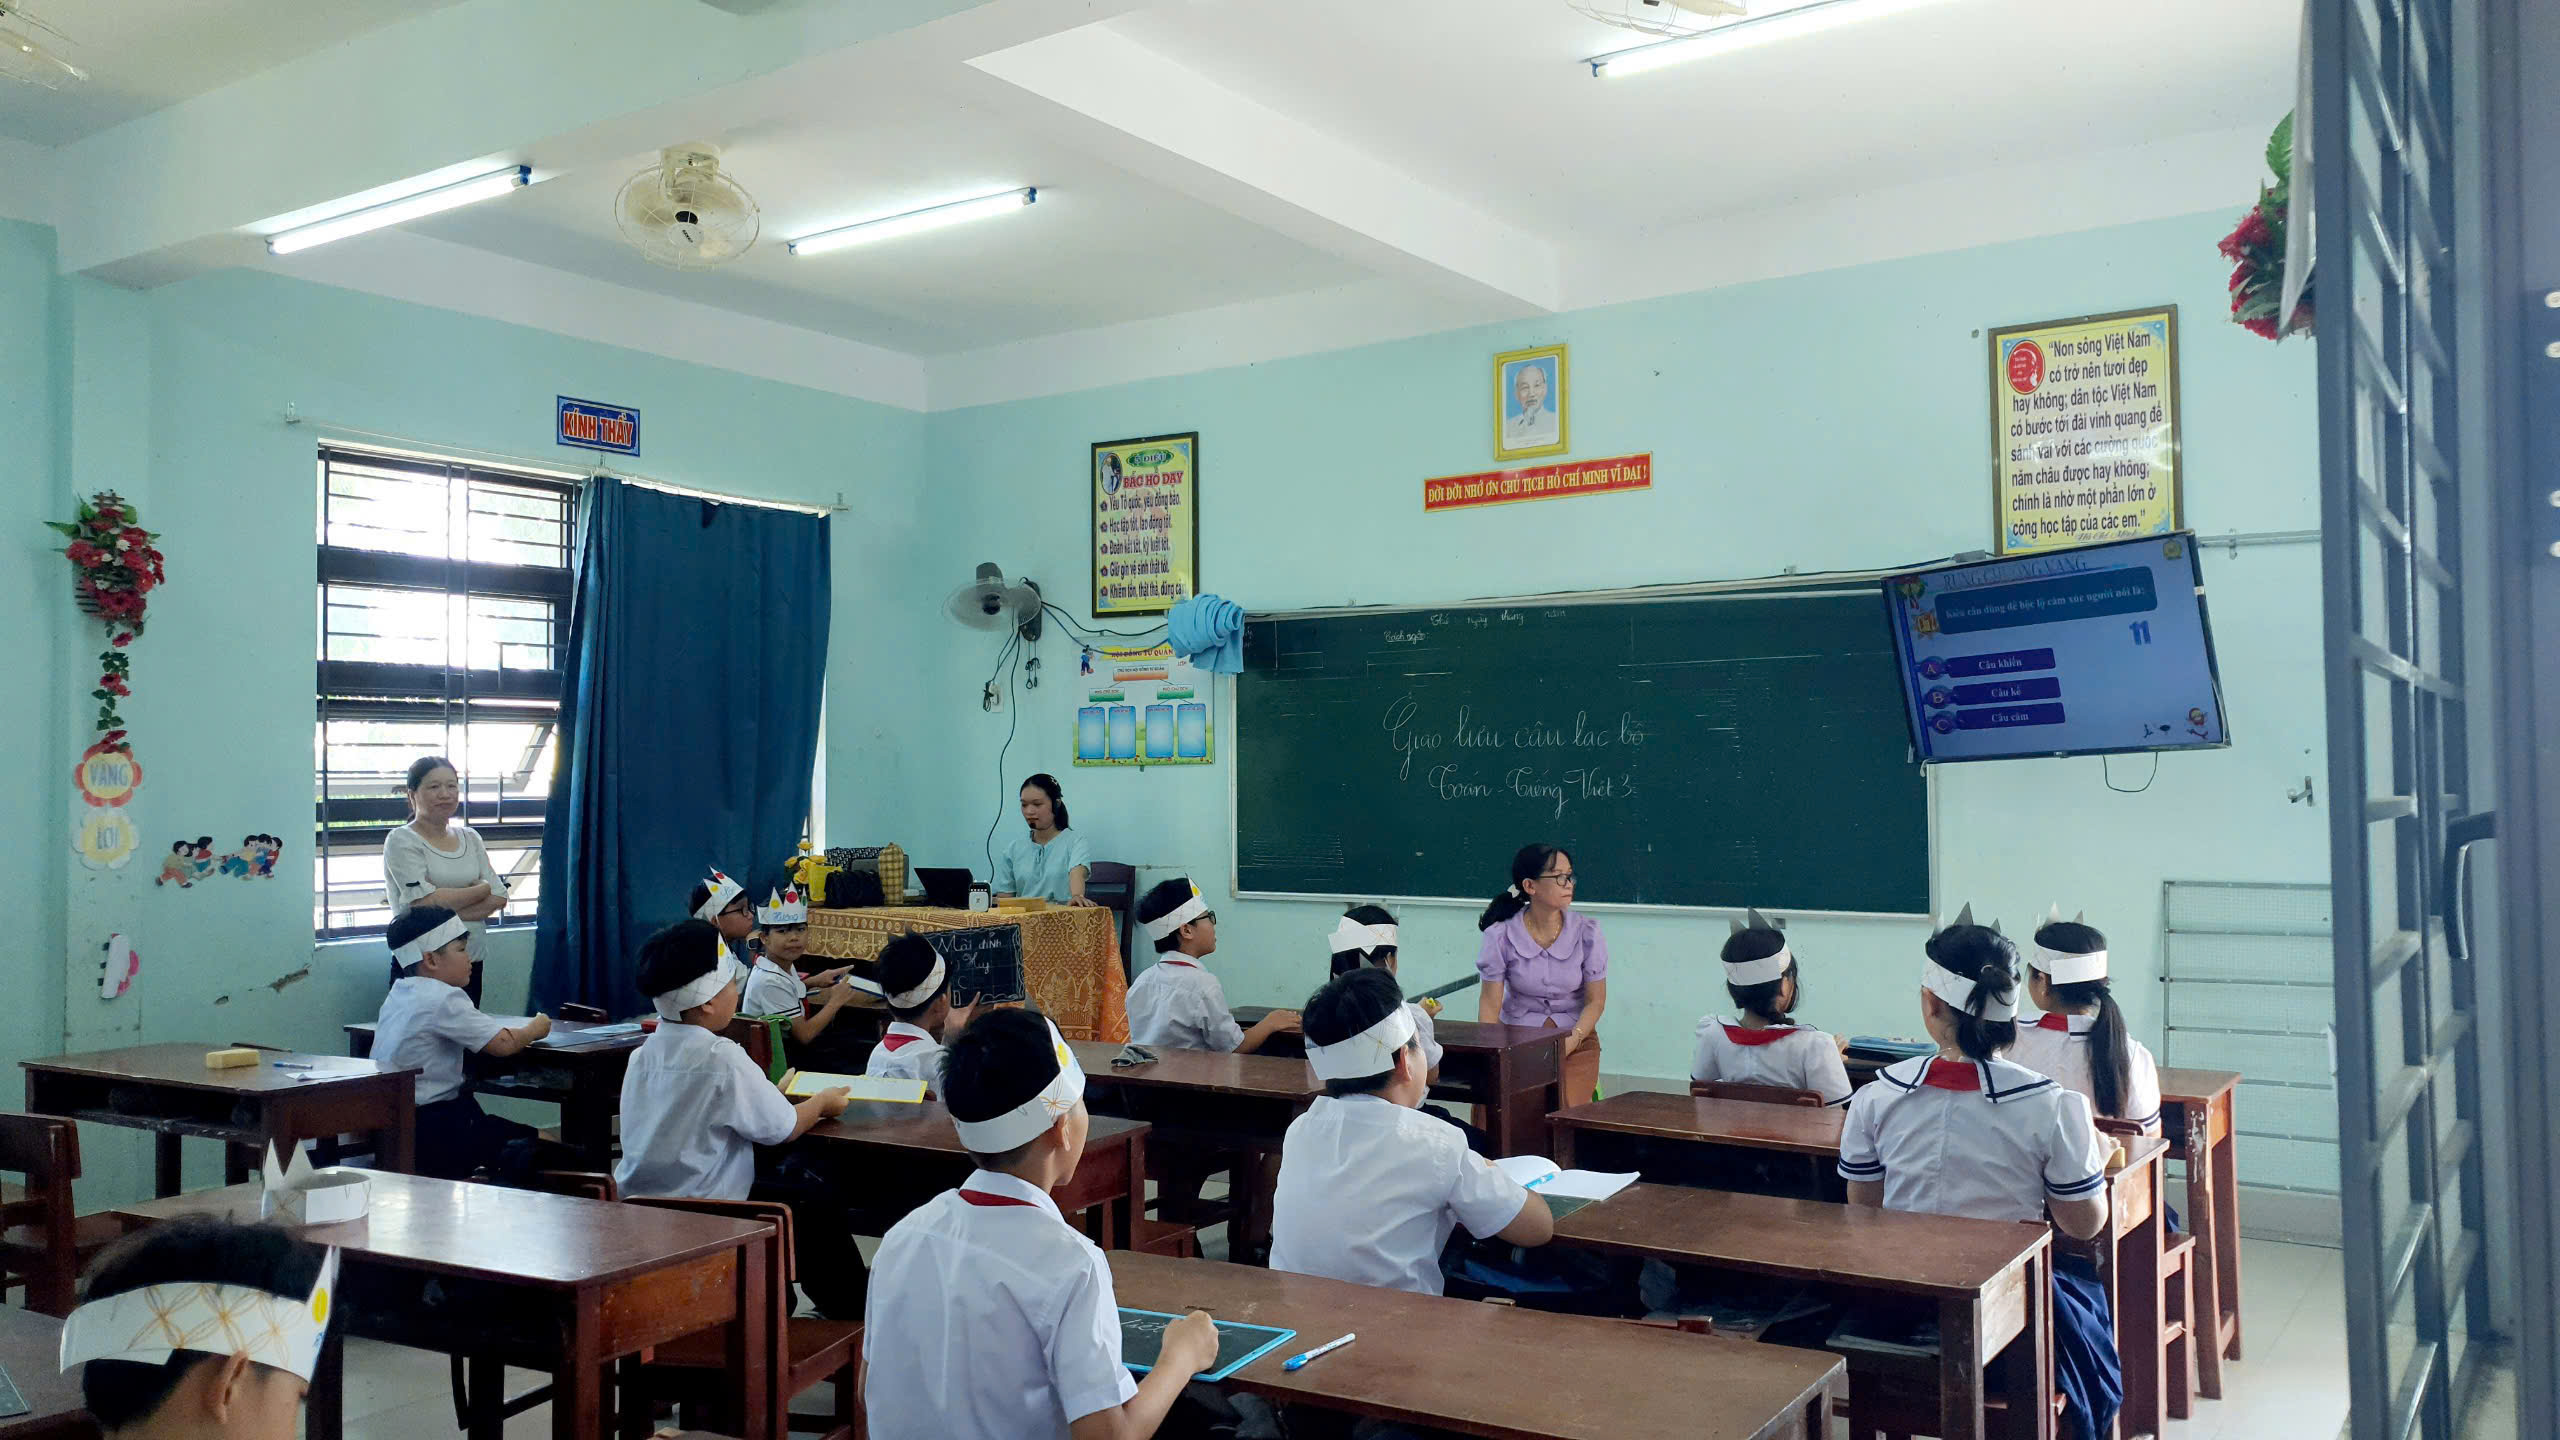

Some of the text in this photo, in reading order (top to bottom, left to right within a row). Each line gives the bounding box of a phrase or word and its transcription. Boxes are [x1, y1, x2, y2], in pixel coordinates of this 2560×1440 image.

[2077, 337, 2102, 357] sông
[2105, 333, 2125, 354] Việt
[2128, 332, 2151, 348] Nam
[2050, 367, 2061, 383] có
[2064, 362, 2080, 382] trở
[2082, 363, 2101, 381] nên
[2104, 360, 2126, 377] tươi
[2128, 358, 2148, 379] đẹp
[2013, 395, 2030, 415] hay
[2070, 390, 2089, 407] dân
[2092, 388, 2108, 407] tộc
[2111, 385, 2131, 404] Việt
[2133, 383, 2157, 397] Nam
[563, 408, 634, 446] KÍNH THẦY
[2011, 401, 2162, 437] có bước tới đài vinh quang để
[2038, 443, 2052, 459] vai
[2055, 439, 2071, 458] với
[2074, 439, 2092, 456] các
[1145, 466, 1160, 486] HỒ
[1162, 471, 1184, 488] DẠY
[1428, 482, 1445, 503] ĐỜI
[1447, 481, 1463, 501] ĐỜI
[1464, 479, 1484, 499] NHỚ
[1486, 479, 1498, 495] ƠN
[1501, 474, 1520, 494] CHỦ
[1522, 476, 1545, 495] TỊCH
[1547, 468, 1561, 490] HỒ
[1563, 470, 1580, 487] CHÍ
[1582, 470, 1608, 485] MINH
[1610, 464, 1622, 482] VĨ
[1623, 465, 1641, 483] ĐẠI
[2012, 469, 2032, 487] năm
[2036, 466, 2060, 485] châu
[2063, 465, 2090, 484] được
[2093, 464, 2111, 483] hay
[1110, 496, 1120, 511] Yêu
[1144, 496, 1154, 513] yêu
[2013, 482, 2156, 512] chính là nhờ một phần lớn ở
[1110, 519, 1120, 536] Học
[1121, 517, 1129, 535] tập
[1140, 517, 1148, 530] lao
[1149, 515, 1163, 534] động
[2013, 520, 2037, 539] công
[2041, 519, 2058, 539] học
[2061, 516, 2077, 540] tập
[2080, 513, 2099, 531] của
[2101, 513, 2119, 530] các
[1110, 541, 1124, 555] Đoàn
[1110, 561, 1120, 577] Giữ
[1121, 562, 1129, 579] gìn
[1130, 562, 1136, 579] vệ
[1138, 561, 1149, 575] sinh
[1150, 559, 1160, 577] thật
[1110, 583, 1127, 599] Khiêm
[1139, 582, 1149, 600] thật
[1161, 582, 1174, 599] dũng
[2129, 620, 2151, 645] 11
[1928, 663, 1937, 674] A
[1978, 654, 2022, 671] Câu khiến
[1933, 691, 1944, 704] B
[1991, 687, 2008, 698] Câu
[1936, 719, 1950, 730] C
[1991, 712, 2008, 722] Câu
[1384, 692, 1442, 781] Giao
[1515, 721, 1566, 748] câu
[1428, 763, 1495, 800] Toán
